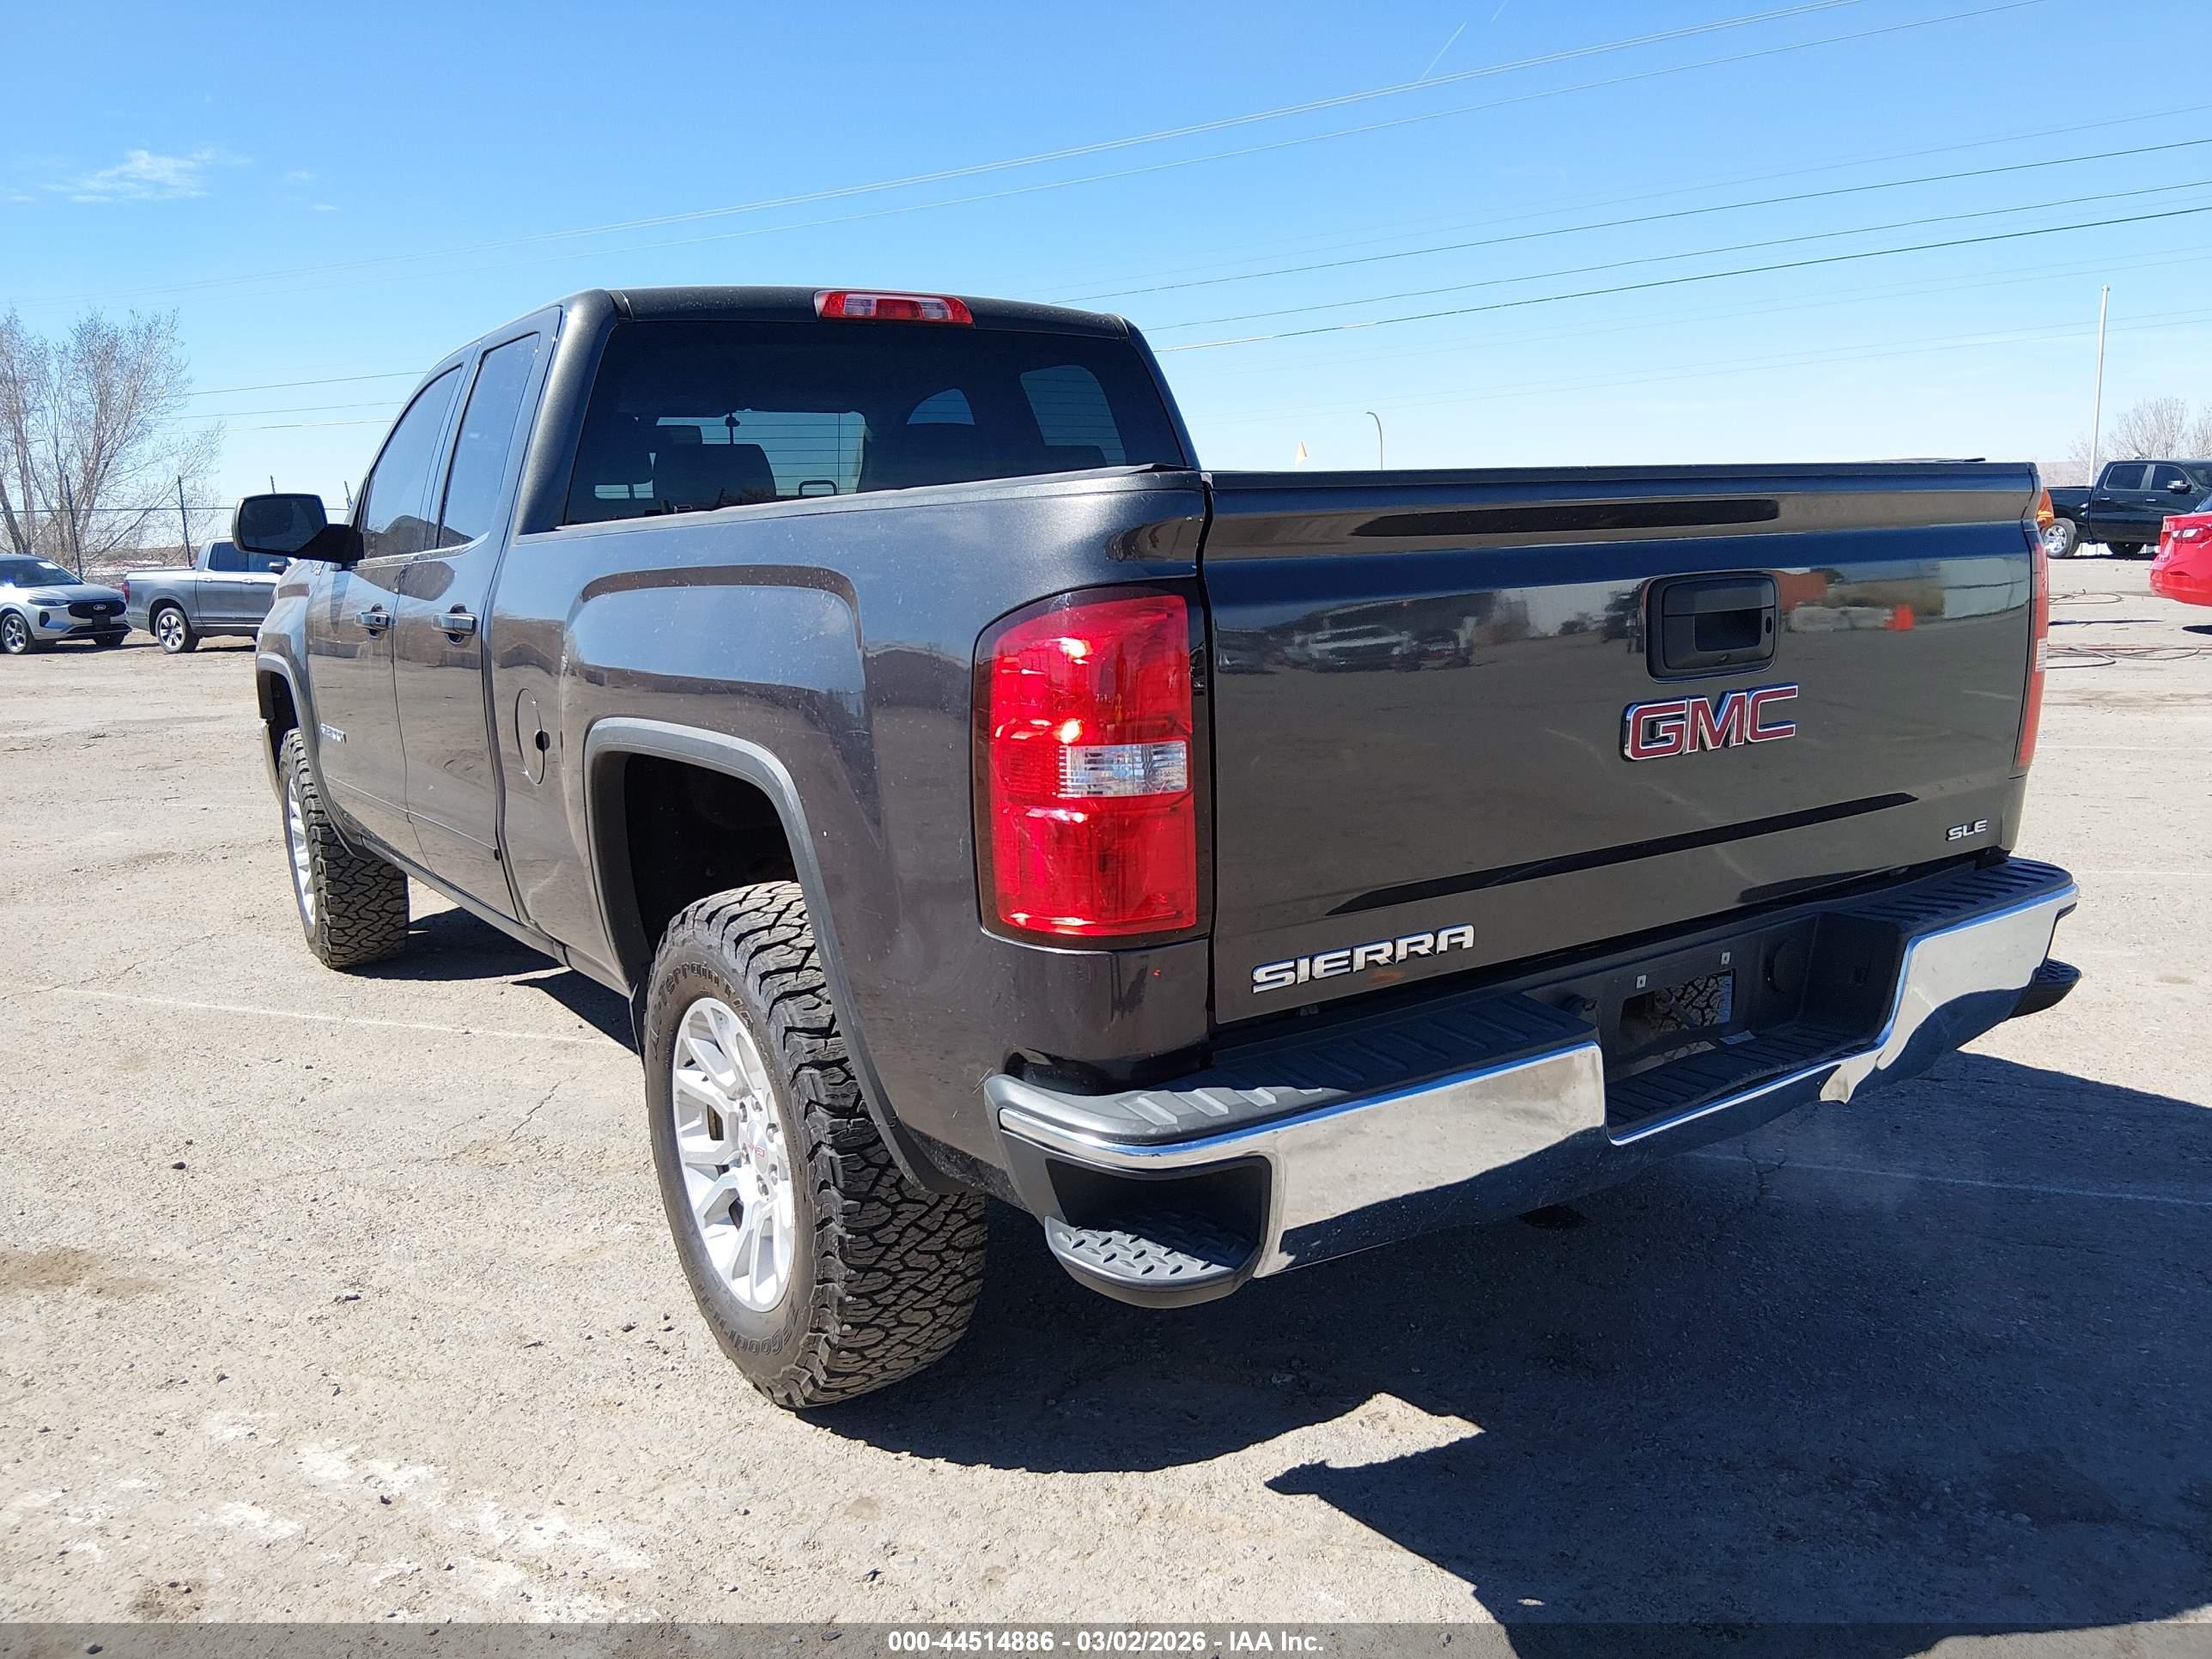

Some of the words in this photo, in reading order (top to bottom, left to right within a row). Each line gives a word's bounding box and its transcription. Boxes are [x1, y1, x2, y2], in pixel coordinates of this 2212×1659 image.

[1620, 682, 1799, 762] GMC
[1947, 819, 1988, 842] SLE
[1251, 923, 1474, 994] SIERRA
